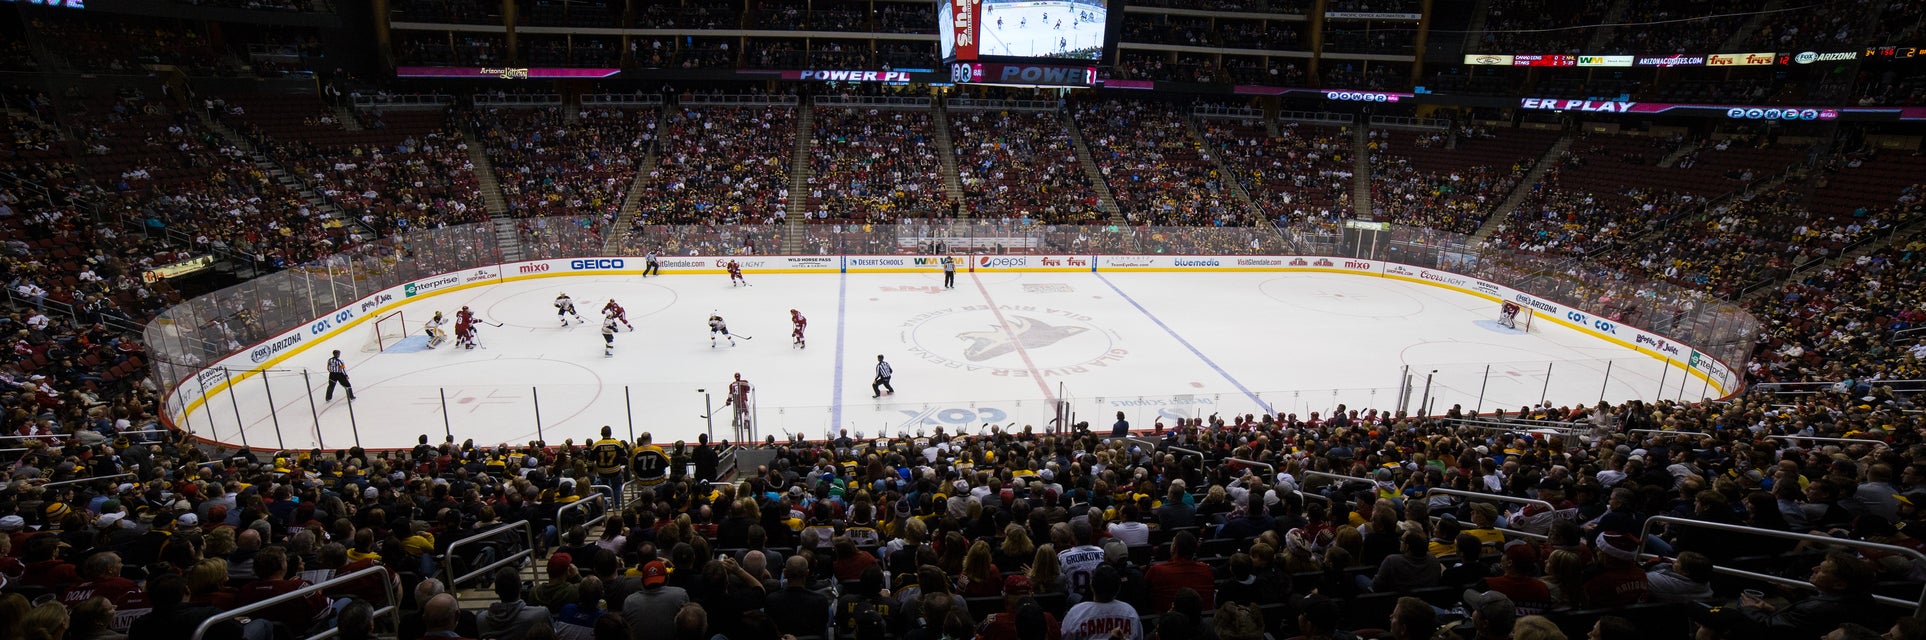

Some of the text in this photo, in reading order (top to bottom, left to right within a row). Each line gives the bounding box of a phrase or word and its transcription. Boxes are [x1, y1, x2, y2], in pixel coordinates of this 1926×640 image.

[1746, 54, 1773, 64] fry's
[1817, 51, 1858, 62] ARIZONA
[1906, 47, 1916, 58] 2
[1580, 56, 1604, 64] WM
[1709, 55, 1733, 65] fry's
[1779, 56, 1790, 65] 12
[479, 67, 529, 80] Arizona Lottery
[799, 69, 912, 82] POWER PL
[1327, 91, 1388, 103] POWER
[1521, 97, 1637, 113] ER PLAY
[1727, 108, 1820, 121] POWER
[571, 259, 624, 270] GEICO
[858, 258, 904, 266] DESERT SCHOOLS
[914, 257, 938, 265] WM
[992, 256, 1027, 268] pepsi
[1040, 256, 1061, 267] fry's
[1066, 256, 1087, 267] fry's
[1174, 257, 1220, 267] bluemedia
[1237, 258, 1282, 266] VisitGlendale.com
[407, 276, 458, 294] enterprise
[1442, 278, 1467, 287] LIGHT
[1530, 299, 1558, 315] ARIZONA
[336, 308, 354, 324] COX
[1046, 307, 1094, 323] GILA
[1567, 310, 1589, 326] COX
[311, 318, 331, 335] COX
[1594, 319, 1618, 335] COX
[254, 332, 302, 359] FOX ARIZONA
[1663, 343, 1679, 356] Juice
[906, 346, 1130, 378] GILA RIVER ARENA
[898, 405, 1008, 428] COX
[597, 451, 617, 467] 17
[637, 454, 658, 472] 77
[64, 588, 96, 602] DOAN
[1080, 617, 1132, 637] CANADA
